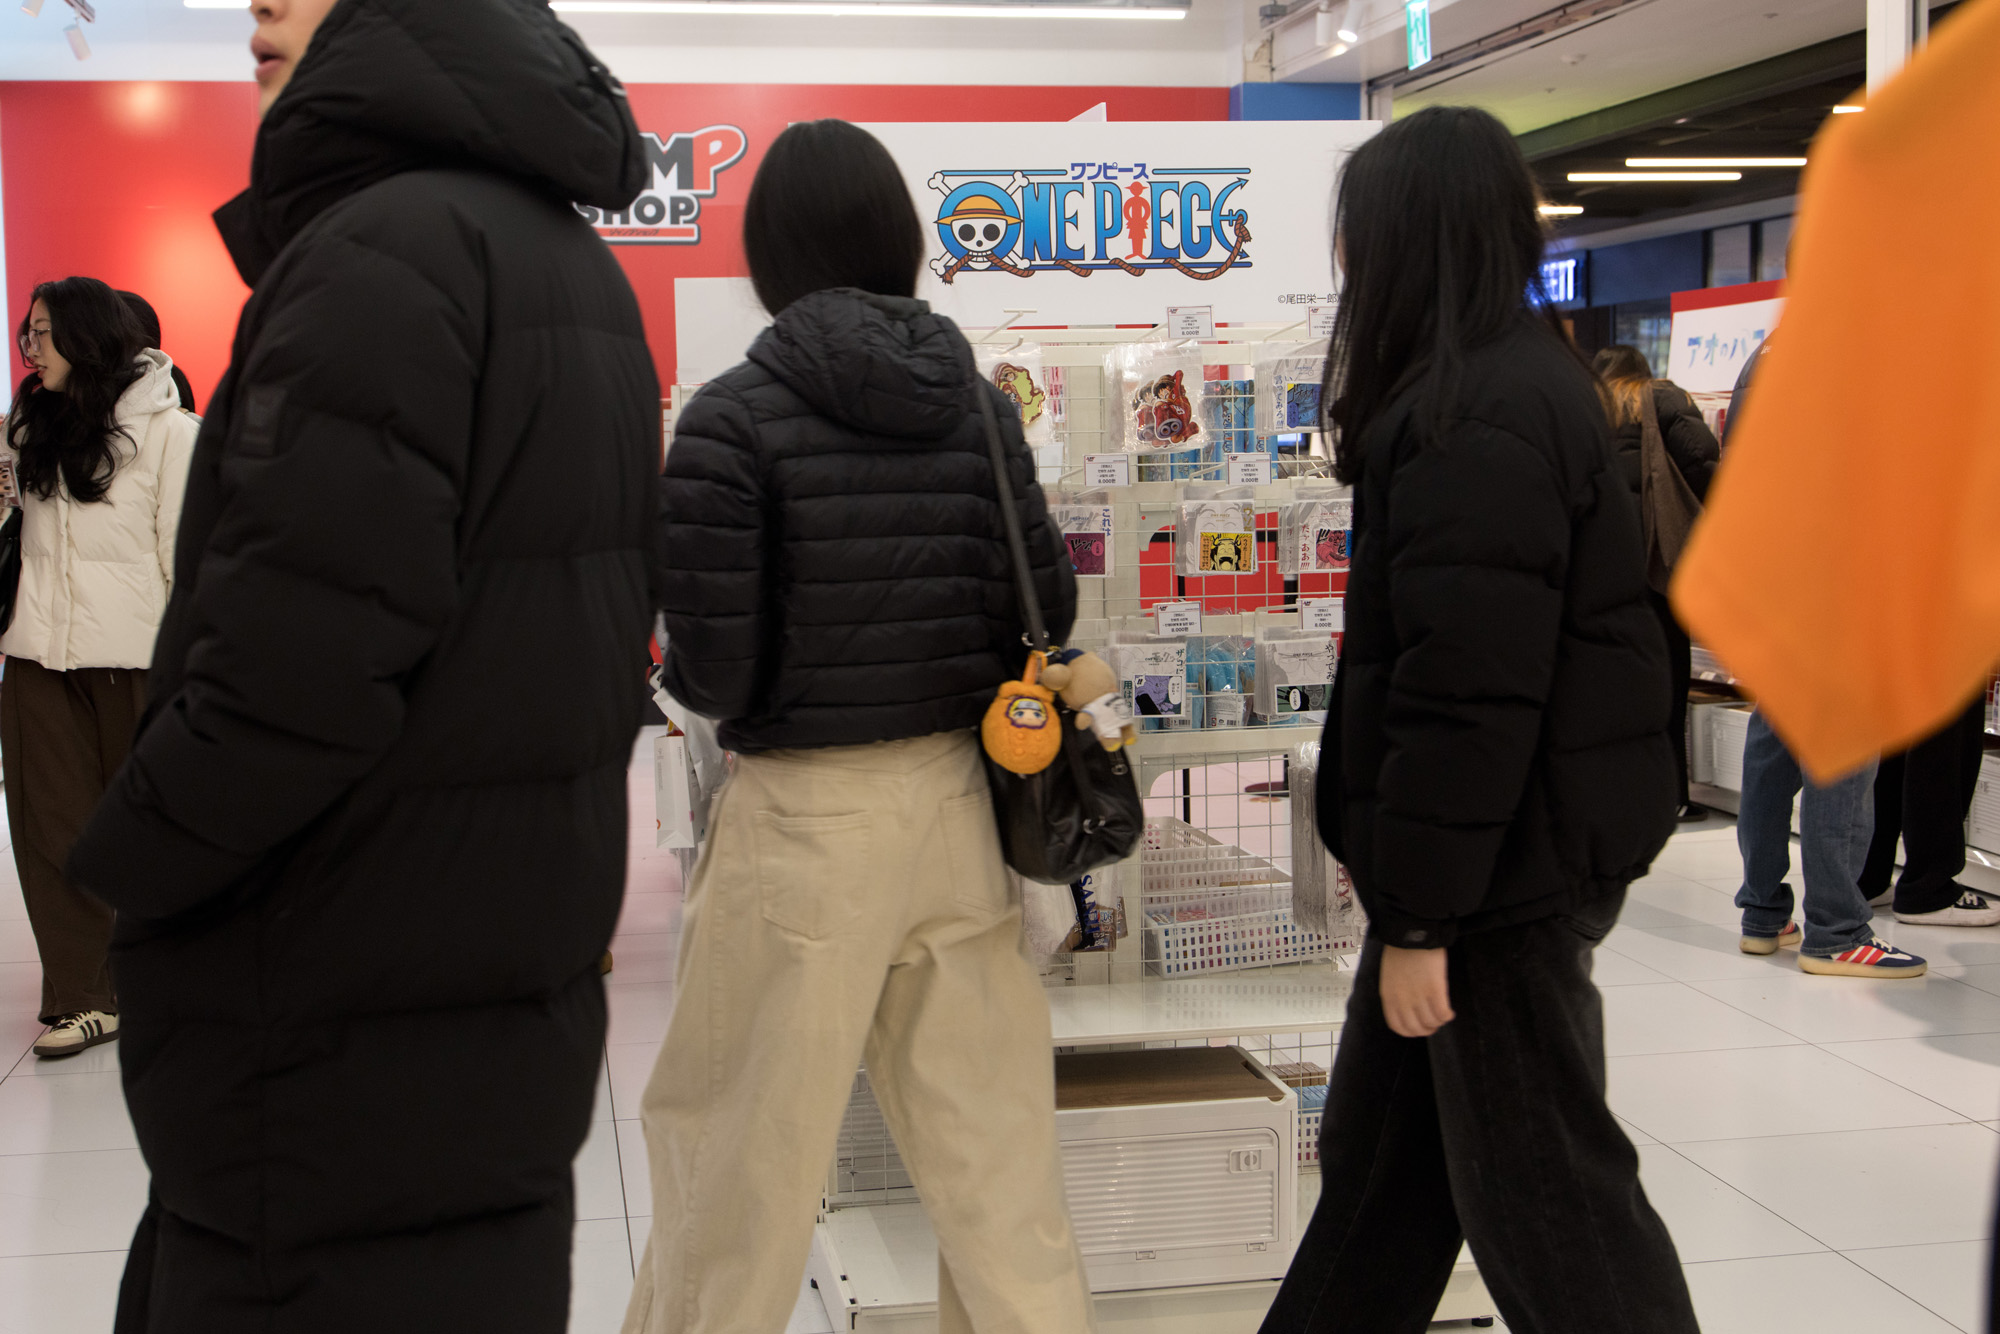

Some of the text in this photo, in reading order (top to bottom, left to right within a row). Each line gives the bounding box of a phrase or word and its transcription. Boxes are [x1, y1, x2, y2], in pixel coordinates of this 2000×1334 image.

[1070, 162, 1149, 180] ワンピース
[937, 179, 1250, 264] ONE PIECE
